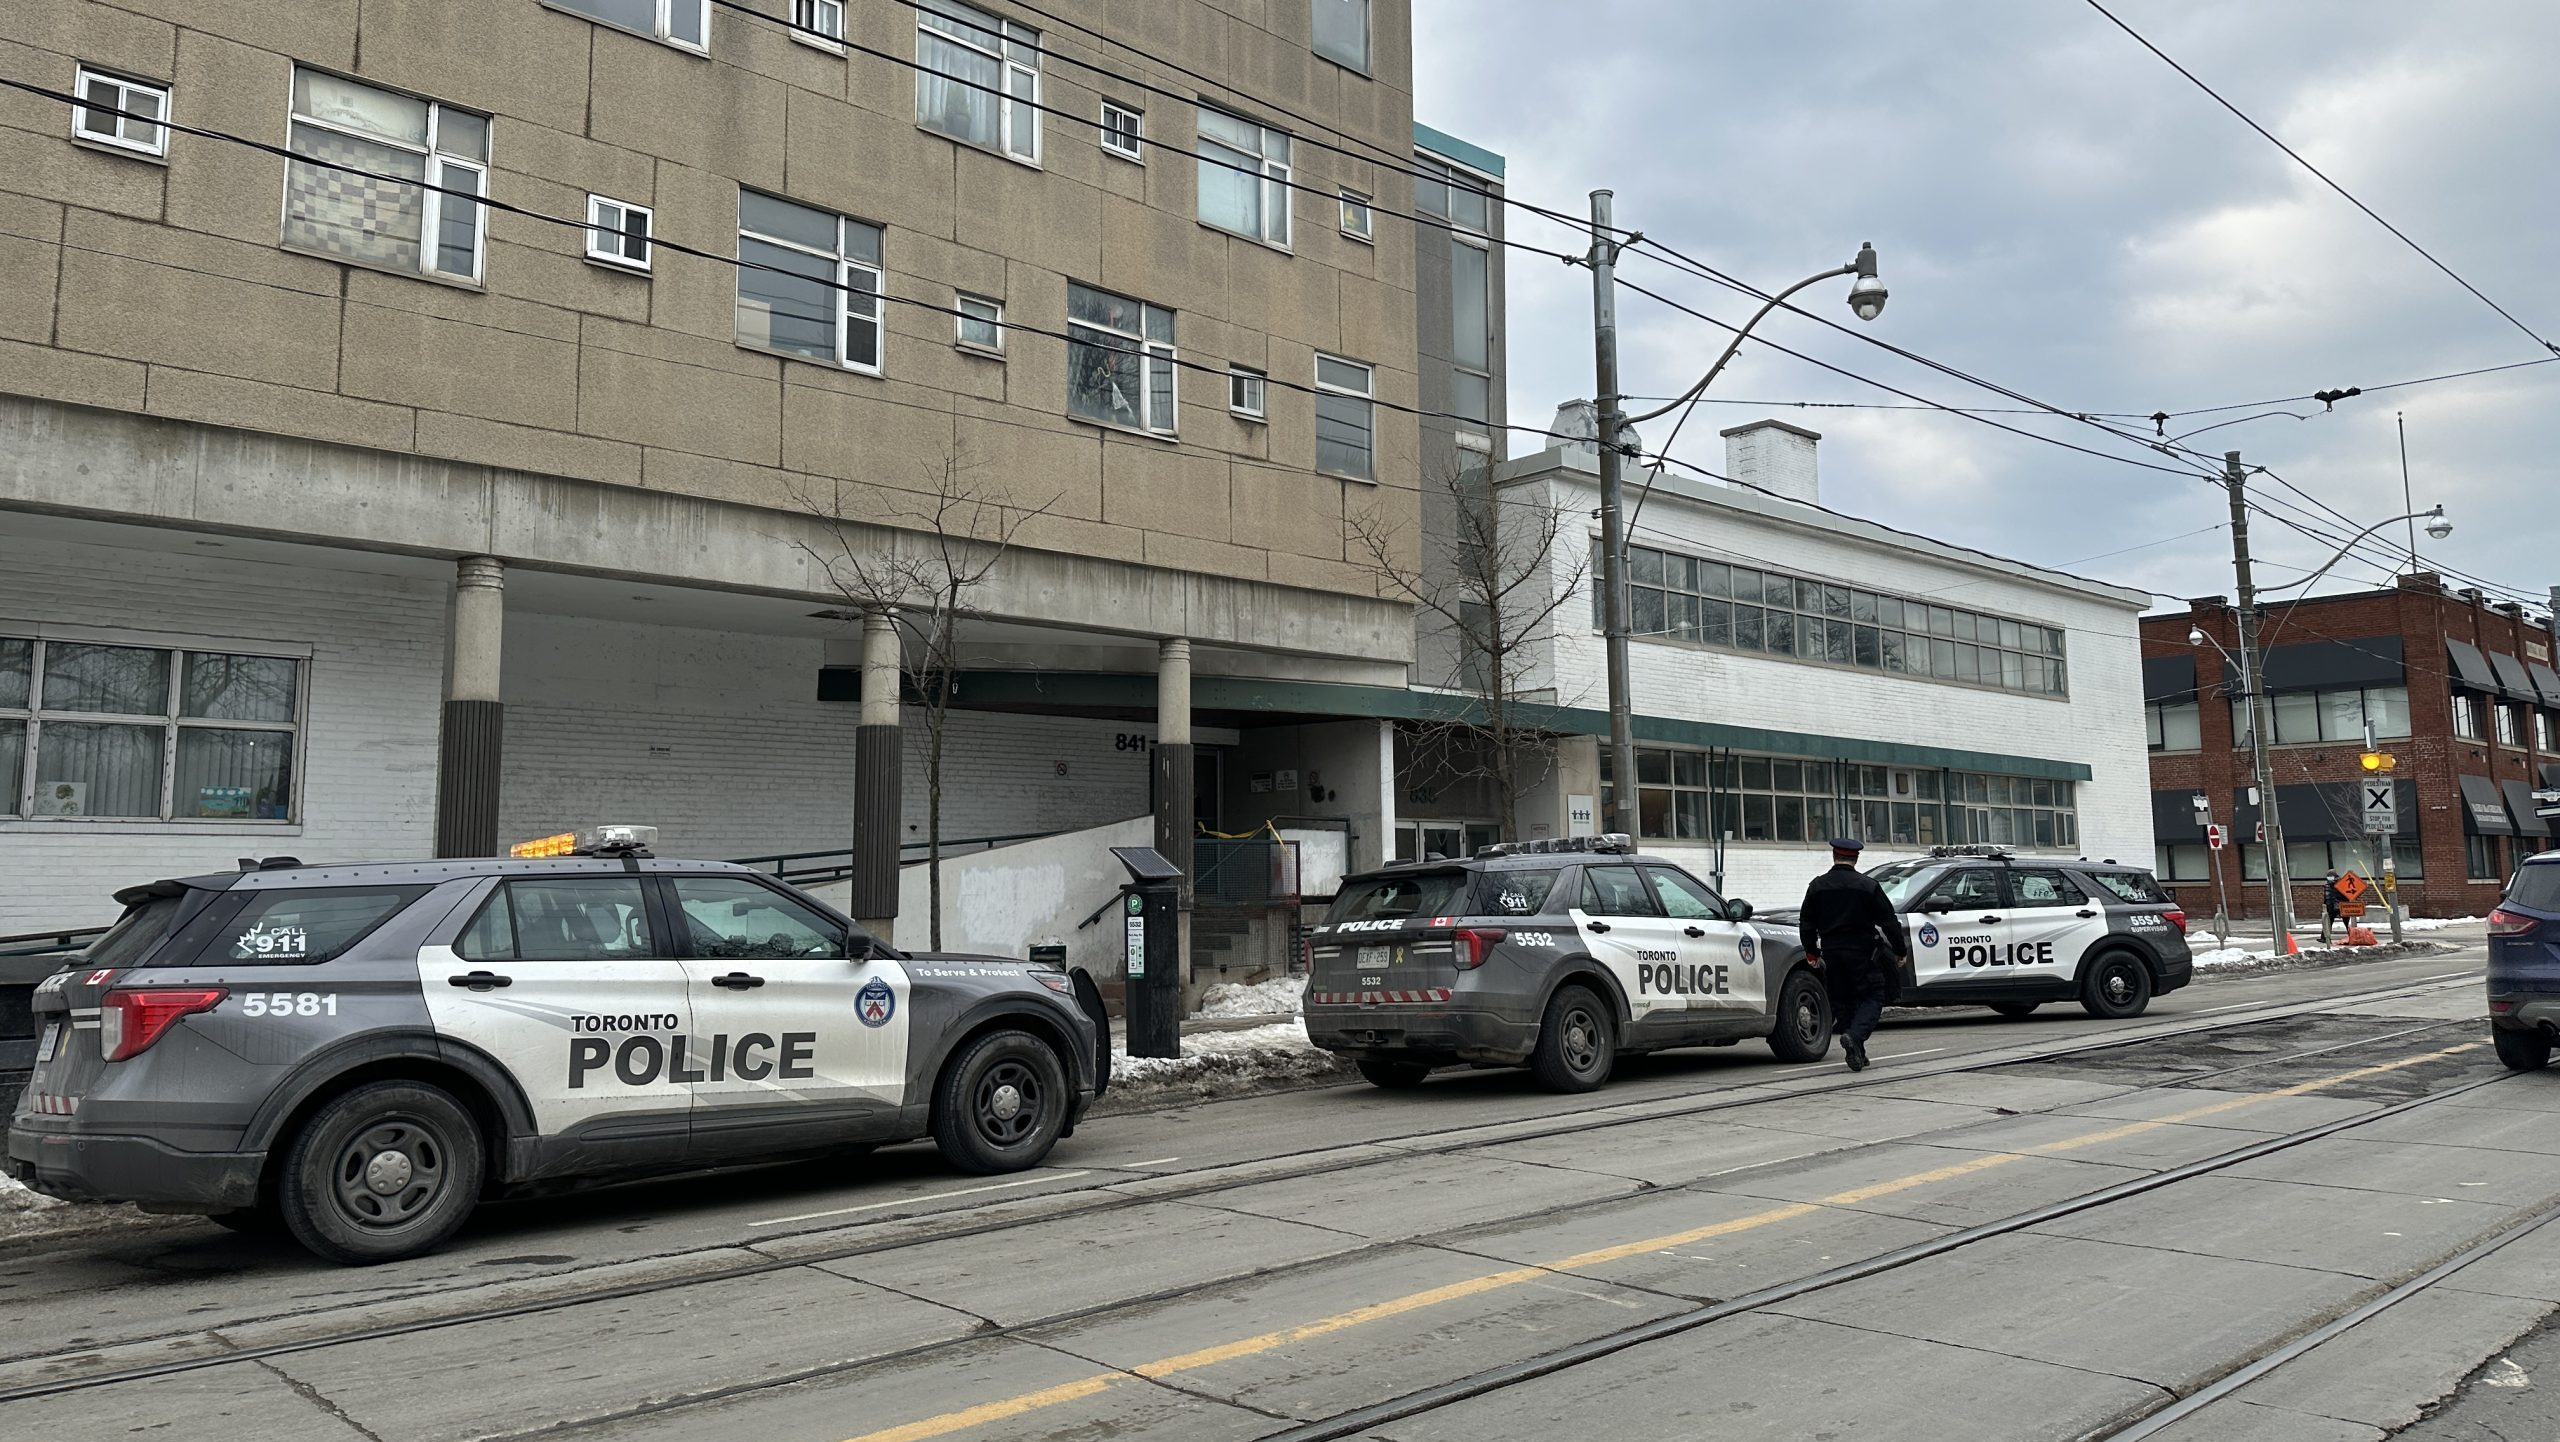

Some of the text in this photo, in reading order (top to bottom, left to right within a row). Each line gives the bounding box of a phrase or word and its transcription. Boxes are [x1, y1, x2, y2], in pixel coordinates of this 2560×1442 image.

[1115, 733, 1146, 752] 841
[1337, 919, 1406, 933] POLICE
[2130, 915, 2160, 926] 55S4
[271, 927, 307, 935] CALL
[1515, 932, 1555, 947] 5532
[1948, 935, 1991, 944] TORONTO
[1637, 950, 1677, 961] TORONTO
[1949, 941, 2054, 968] POLICE
[916, 968, 1021, 977] To Serve & Protect
[1638, 964, 1730, 995] POLICE
[1361, 976, 1382, 986] 5532
[242, 992, 338, 1017] 5581
[571, 1013, 678, 1032] TORONTO
[568, 1031, 817, 1089] POLICE
